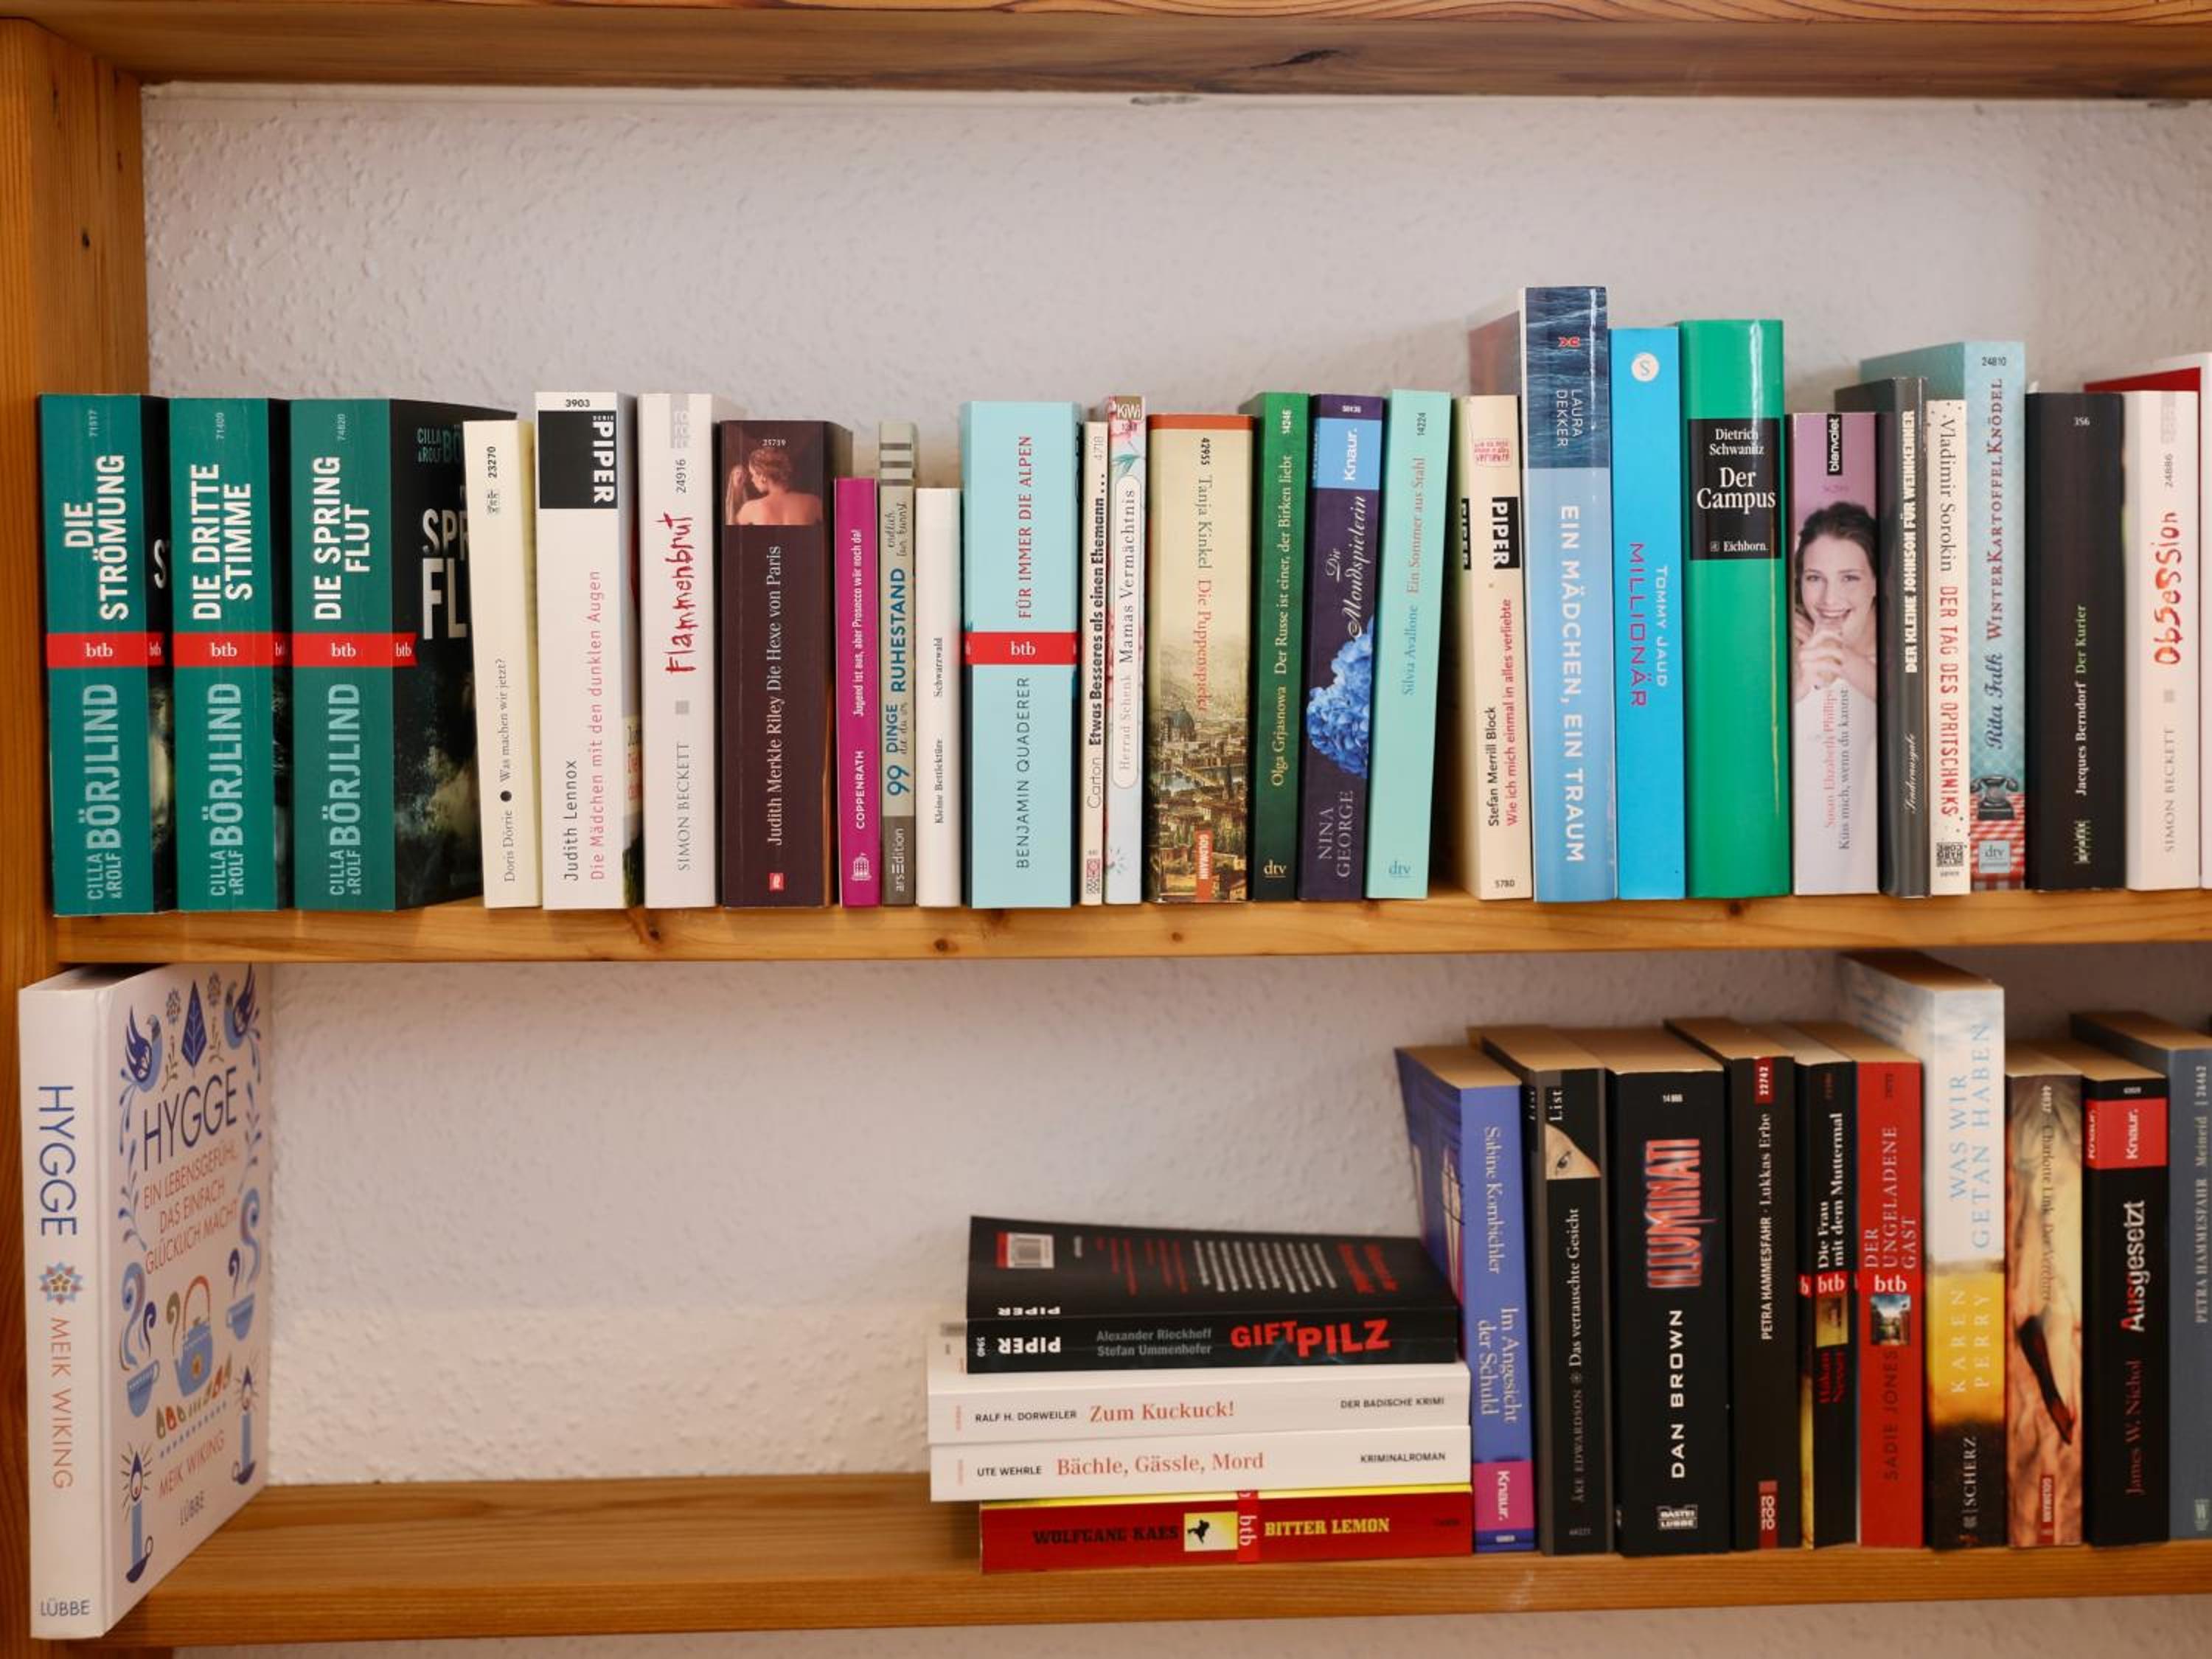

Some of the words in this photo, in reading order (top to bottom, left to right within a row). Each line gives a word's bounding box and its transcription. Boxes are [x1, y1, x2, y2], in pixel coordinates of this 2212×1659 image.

[566, 399, 590, 408] 3903
[1557, 390, 1568, 448] DEKKER
[1571, 389, 1582, 437] LAURA
[1716, 429, 1759, 440] Dietrich
[1829, 418, 1840, 471] blanvalet
[487, 447, 498, 479] 23270
[594, 421, 614, 502] PIPER
[676, 459, 686, 493] 24916
[1018, 436, 1032, 487] ALPEN
[1280, 456, 1293, 483] liebt
[1411, 458, 1425, 488] Stahl
[1720, 468, 1756, 488] Der
[192, 465, 219, 563] DRITTE
[313, 458, 341, 564] SPRING
[1018, 494, 1032, 520] DIE
[1198, 476, 1213, 511] Tanja
[1279, 487, 1292, 527] Birken
[1412, 493, 1422, 512] aus
[1697, 489, 1775, 514] Campus
[65, 502, 94, 547] DIE
[94, 455, 128, 620] STRÖMUNG
[224, 484, 252, 600] STIMME
[344, 504, 369, 572] FLUT
[1119, 490, 1135, 599] Vermächtnis
[1198, 522, 1212, 568] Kinkel
[1278, 532, 1290, 552] der
[1408, 518, 1422, 568] Sommer
[1493, 503, 1509, 564] PIPER
[1561, 506, 1580, 549] EIN
[766, 546, 781, 585] Paris
[1018, 528, 1032, 581] IMMER
[1279, 556, 1290, 588] einer,
[1343, 495, 1368, 638] Mondspielerin
[193, 575, 221, 619] DIE
[313, 575, 341, 619] DIE
[587, 571, 603, 622] Augen
[657, 512, 698, 674] Flammenbrut
[770, 592, 781, 617] von
[1016, 588, 1032, 618] FÜR
[1198, 580, 1211, 605] Die
[1277, 593, 1289, 608] ist
[1407, 572, 1419, 594] Ein
[1941, 586, 1958, 616] DER
[766, 623, 781, 661] Hexe
[890, 568, 906, 692] RUHESTAND
[1118, 605, 1133, 664] Mamas
[1276, 613, 1288, 647] Russe
[1404, 605, 1419, 657] Avallone
[1500, 599, 1513, 652] verliebte
[1560, 560, 1586, 704] MÄDCHEN,
[1630, 543, 1652, 706] MILLIONÄR
[1941, 623, 1958, 654] TAG
[85, 641, 113, 658] btb
[211, 641, 237, 658] btb
[331, 642, 356, 658] btb
[587, 630, 602, 697] dunklen
[1010, 641, 1036, 656] btb
[1197, 611, 1215, 711] Puppenspieler
[1275, 651, 1287, 674] Der
[1502, 655, 1514, 685] alles
[495, 658, 509, 689] jetzt?
[767, 667, 781, 691] Die
[1402, 661, 1417, 695] Silvia
[1503, 689, 1514, 698] in
[1941, 662, 1958, 693] DES
[498, 692, 508, 711] wir
[588, 704, 602, 734] den
[766, 697, 785, 734] Riley
[1273, 686, 1288, 752] Grjasnowa
[1485, 707, 1496, 740] Block
[498, 714, 509, 756] machen
[884, 704, 899, 753] DINGE
[1015, 678, 1030, 773] QUADERER
[1503, 703, 1515, 749] einmal
[1563, 714, 1582, 757] EIN
[79, 685, 121, 848] BÖRJLIND
[203, 684, 243, 846] BÖRJLIND
[322, 685, 361, 846] BÖRJLIND
[499, 759, 511, 782] Was
[588, 741, 602, 767] mit
[767, 739, 782, 793] Merkle
[1272, 757, 1286, 786] Olga
[1486, 743, 1498, 784] Merrill
[1504, 753, 1516, 778] mich
[1941, 702, 1958, 814] OPRITSCHNIKS
[563, 761, 578, 820] Lennox
[676, 743, 689, 810] BECKETT
[855, 751, 865, 829] COPPENRATH
[887, 765, 909, 796] 99
[1087, 757, 1102, 808] Carton
[1505, 781, 1517, 797] ich
[501, 810, 515, 848] Dörrie
[588, 776, 604, 847] Mädchen
[767, 798, 782, 846] Judith
[1016, 780, 1030, 868] BENJAMIN
[1487, 788, 1499, 827] Stefan
[1506, 801, 1518, 826] Wie
[1565, 768, 1584, 860] TRAUM
[563, 828, 580, 880] Judith
[677, 818, 690, 871] SIMON
[1318, 807, 1333, 860] NINA
[1337, 790, 1353, 877] GEORGE
[87, 854, 103, 900] CILLA
[210, 850, 226, 896] CILLA
[330, 850, 344, 896] CILLA
[502, 852, 515, 882] Doris
[590, 855, 605, 880] Die
[1970, 1023, 1989, 1127] HABEN
[144, 1066, 237, 1171] HYGGE
[1550, 1091, 1562, 1121] List
[1949, 1076, 1965, 1129] WIR
[38, 1087, 76, 1236] HYGGE
[1831, 1113, 1843, 1201] Muttermal
[1950, 1142, 1966, 1199] WAS
[1646, 1139, 1708, 1289] ILLUMINATI
[1882, 1127, 1896, 1269] UNGELADENE
[1972, 1144, 1990, 1248] GETAN
[1566, 1209, 1580, 1259] Gesicht
[1818, 1202, 1829, 1236] Frau
[1831, 1207, 1843, 1241] dem
[1818, 1242, 1829, 1268] Die
[1832, 1245, 1844, 1266] mit
[1865, 1228, 1879, 1269] DER
[1902, 1217, 1916, 1269] GAST
[1874, 1275, 1907, 1292] btb
[2121, 1200, 2152, 1332] Ausgesetzt
[1567, 1263, 1581, 1337] vertauschte
[51, 1318, 70, 1377] MEIK
[998, 1338, 1061, 1354] PIPER
[1568, 1341, 1582, 1366] Das
[1669, 1310, 1683, 1408] BROWN
[1951, 1290, 1966, 1393] KAREN
[1975, 1295, 1989, 1386] PERRY
[975, 1413, 1001, 1422] RALF
[1018, 1411, 1077, 1420] DORWEILER
[1090, 1405, 1133, 1422] Zum
[1141, 1402, 1234, 1419] Kuckuck!
[1340, 1400, 1360, 1408] DER
[1363, 1399, 1413, 1408] BADISCHE
[1416, 1397, 1444, 1405] KRIMI
[51, 1385, 74, 1489] WIKING
[1360, 1452, 1445, 1464] KRIMINALROMAN
[1669, 1424, 1685, 1478] DAN
[1057, 1457, 1129, 1477] Bächle,
[1135, 1455, 1205, 1473] Gässle,
[1212, 1453, 1264, 1470] Mord
[1265, 1520, 1326, 1536] BITTER
[1332, 1518, 1389, 1533] LEMON
[40, 1599, 89, 1615] LÜBBE
